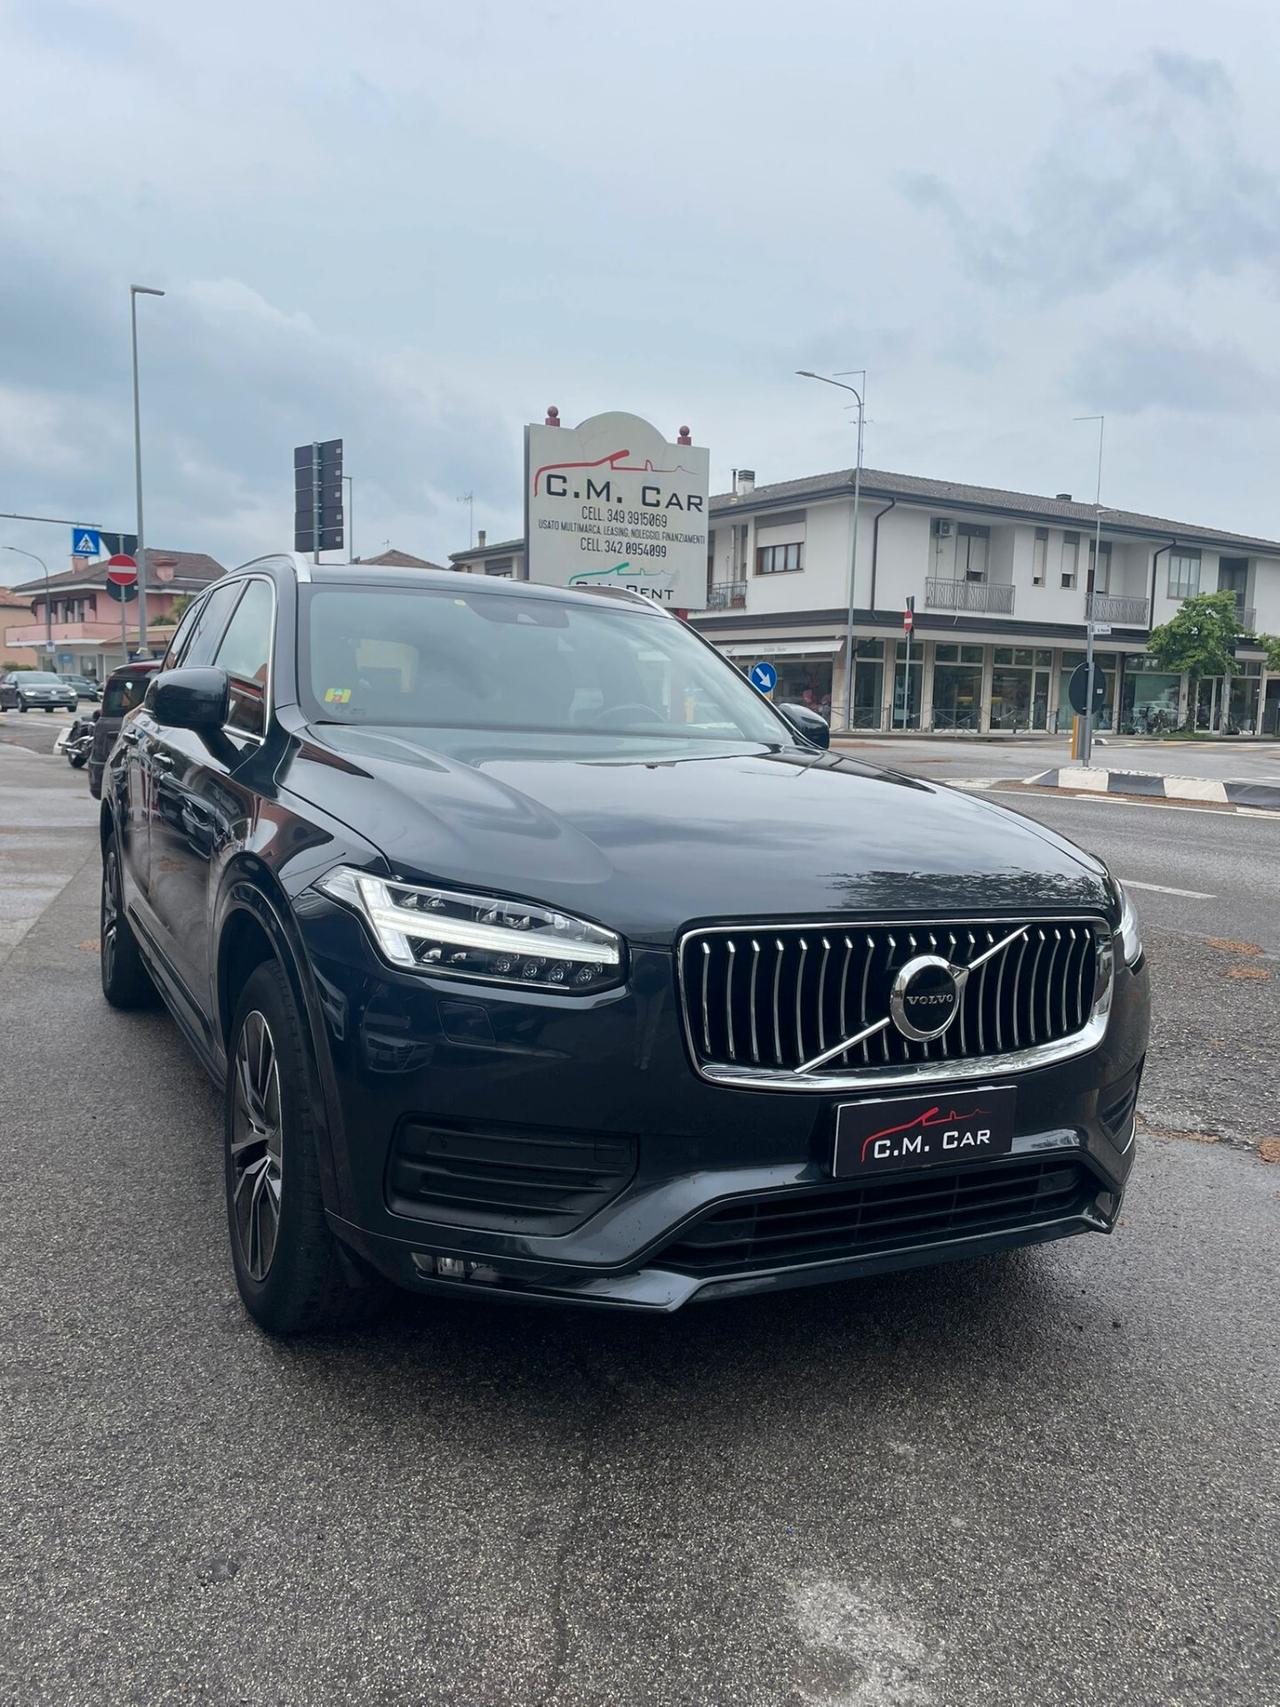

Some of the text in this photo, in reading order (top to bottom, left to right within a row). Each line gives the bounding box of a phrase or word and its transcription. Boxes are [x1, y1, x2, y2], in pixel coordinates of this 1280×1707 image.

[546, 473, 703, 512] C.M. CAR
[538, 519, 560, 530] USATO
[581, 505, 668, 528] CELL. 349 3915069
[604, 540, 624, 554] 342
[625, 541, 667, 558] 0954099
[906, 993, 954, 1006] VOLVO
[873, 1129, 991, 1159] C.M. CAR
